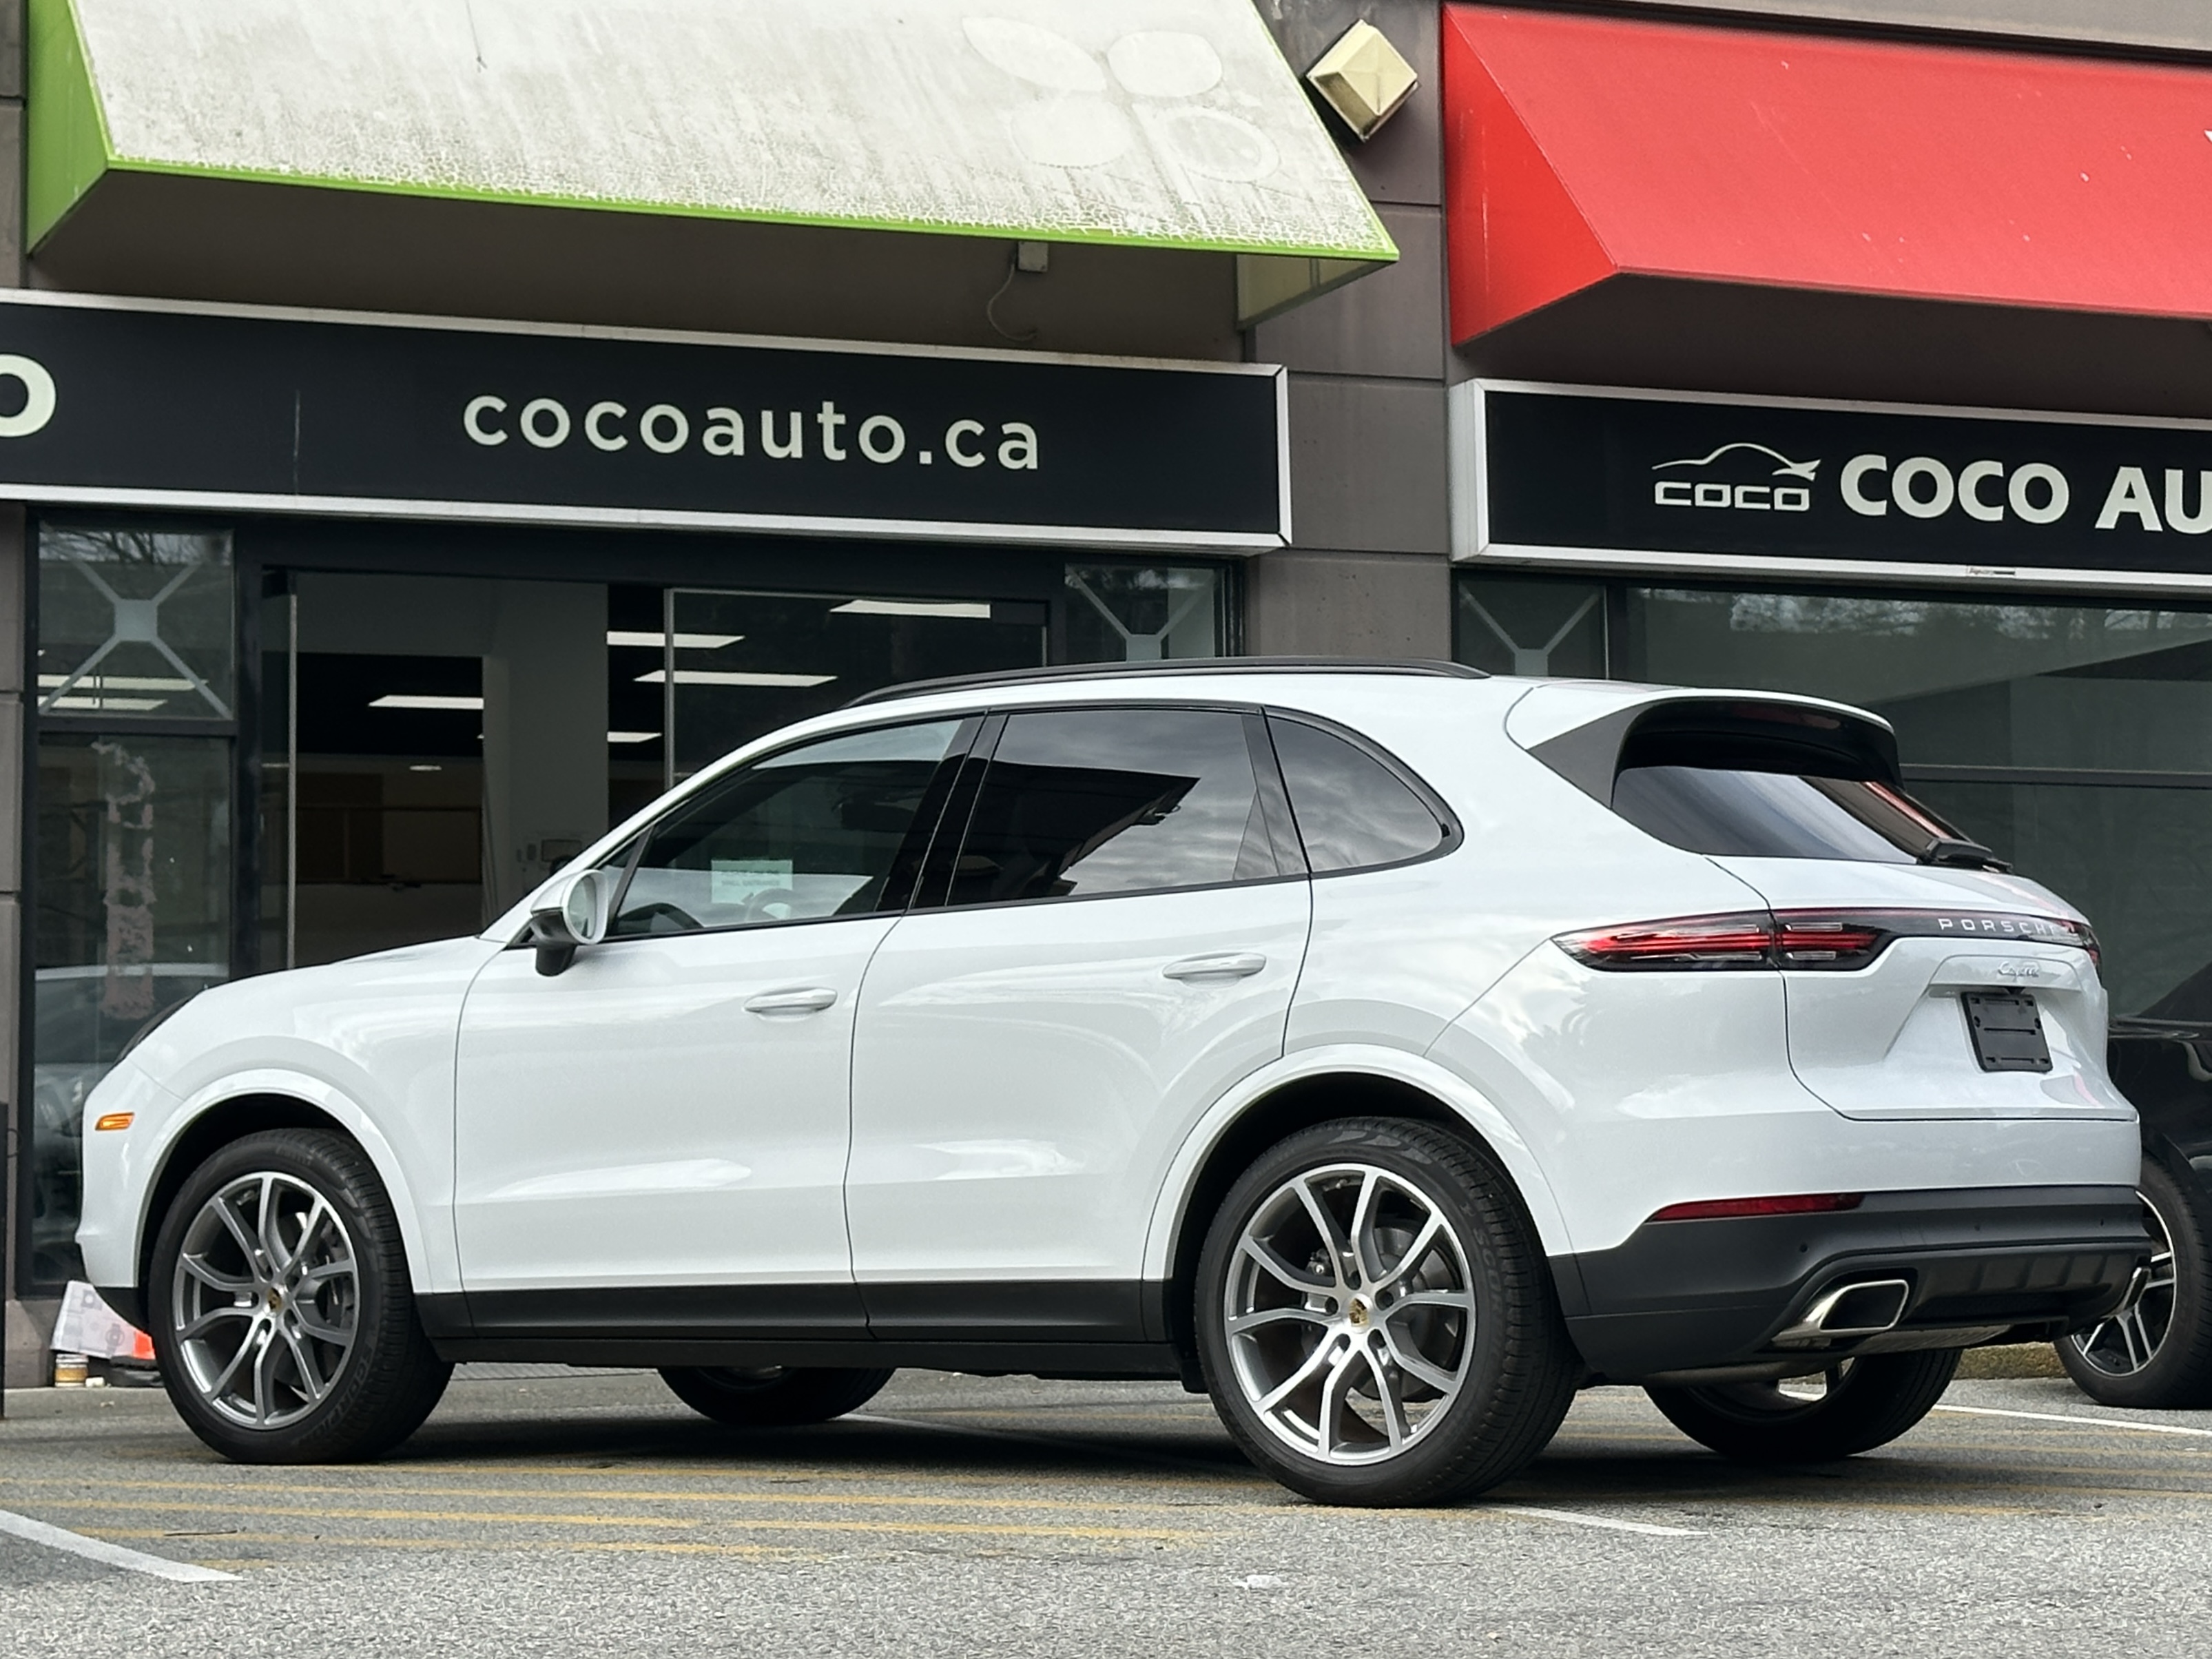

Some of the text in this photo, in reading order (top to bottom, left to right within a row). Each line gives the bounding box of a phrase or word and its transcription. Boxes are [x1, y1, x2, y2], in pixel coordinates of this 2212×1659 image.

[464, 395, 1037, 469] cocoauto.ca
[1655, 481, 1810, 511] COCO
[1840, 454, 2069, 524] COCO
